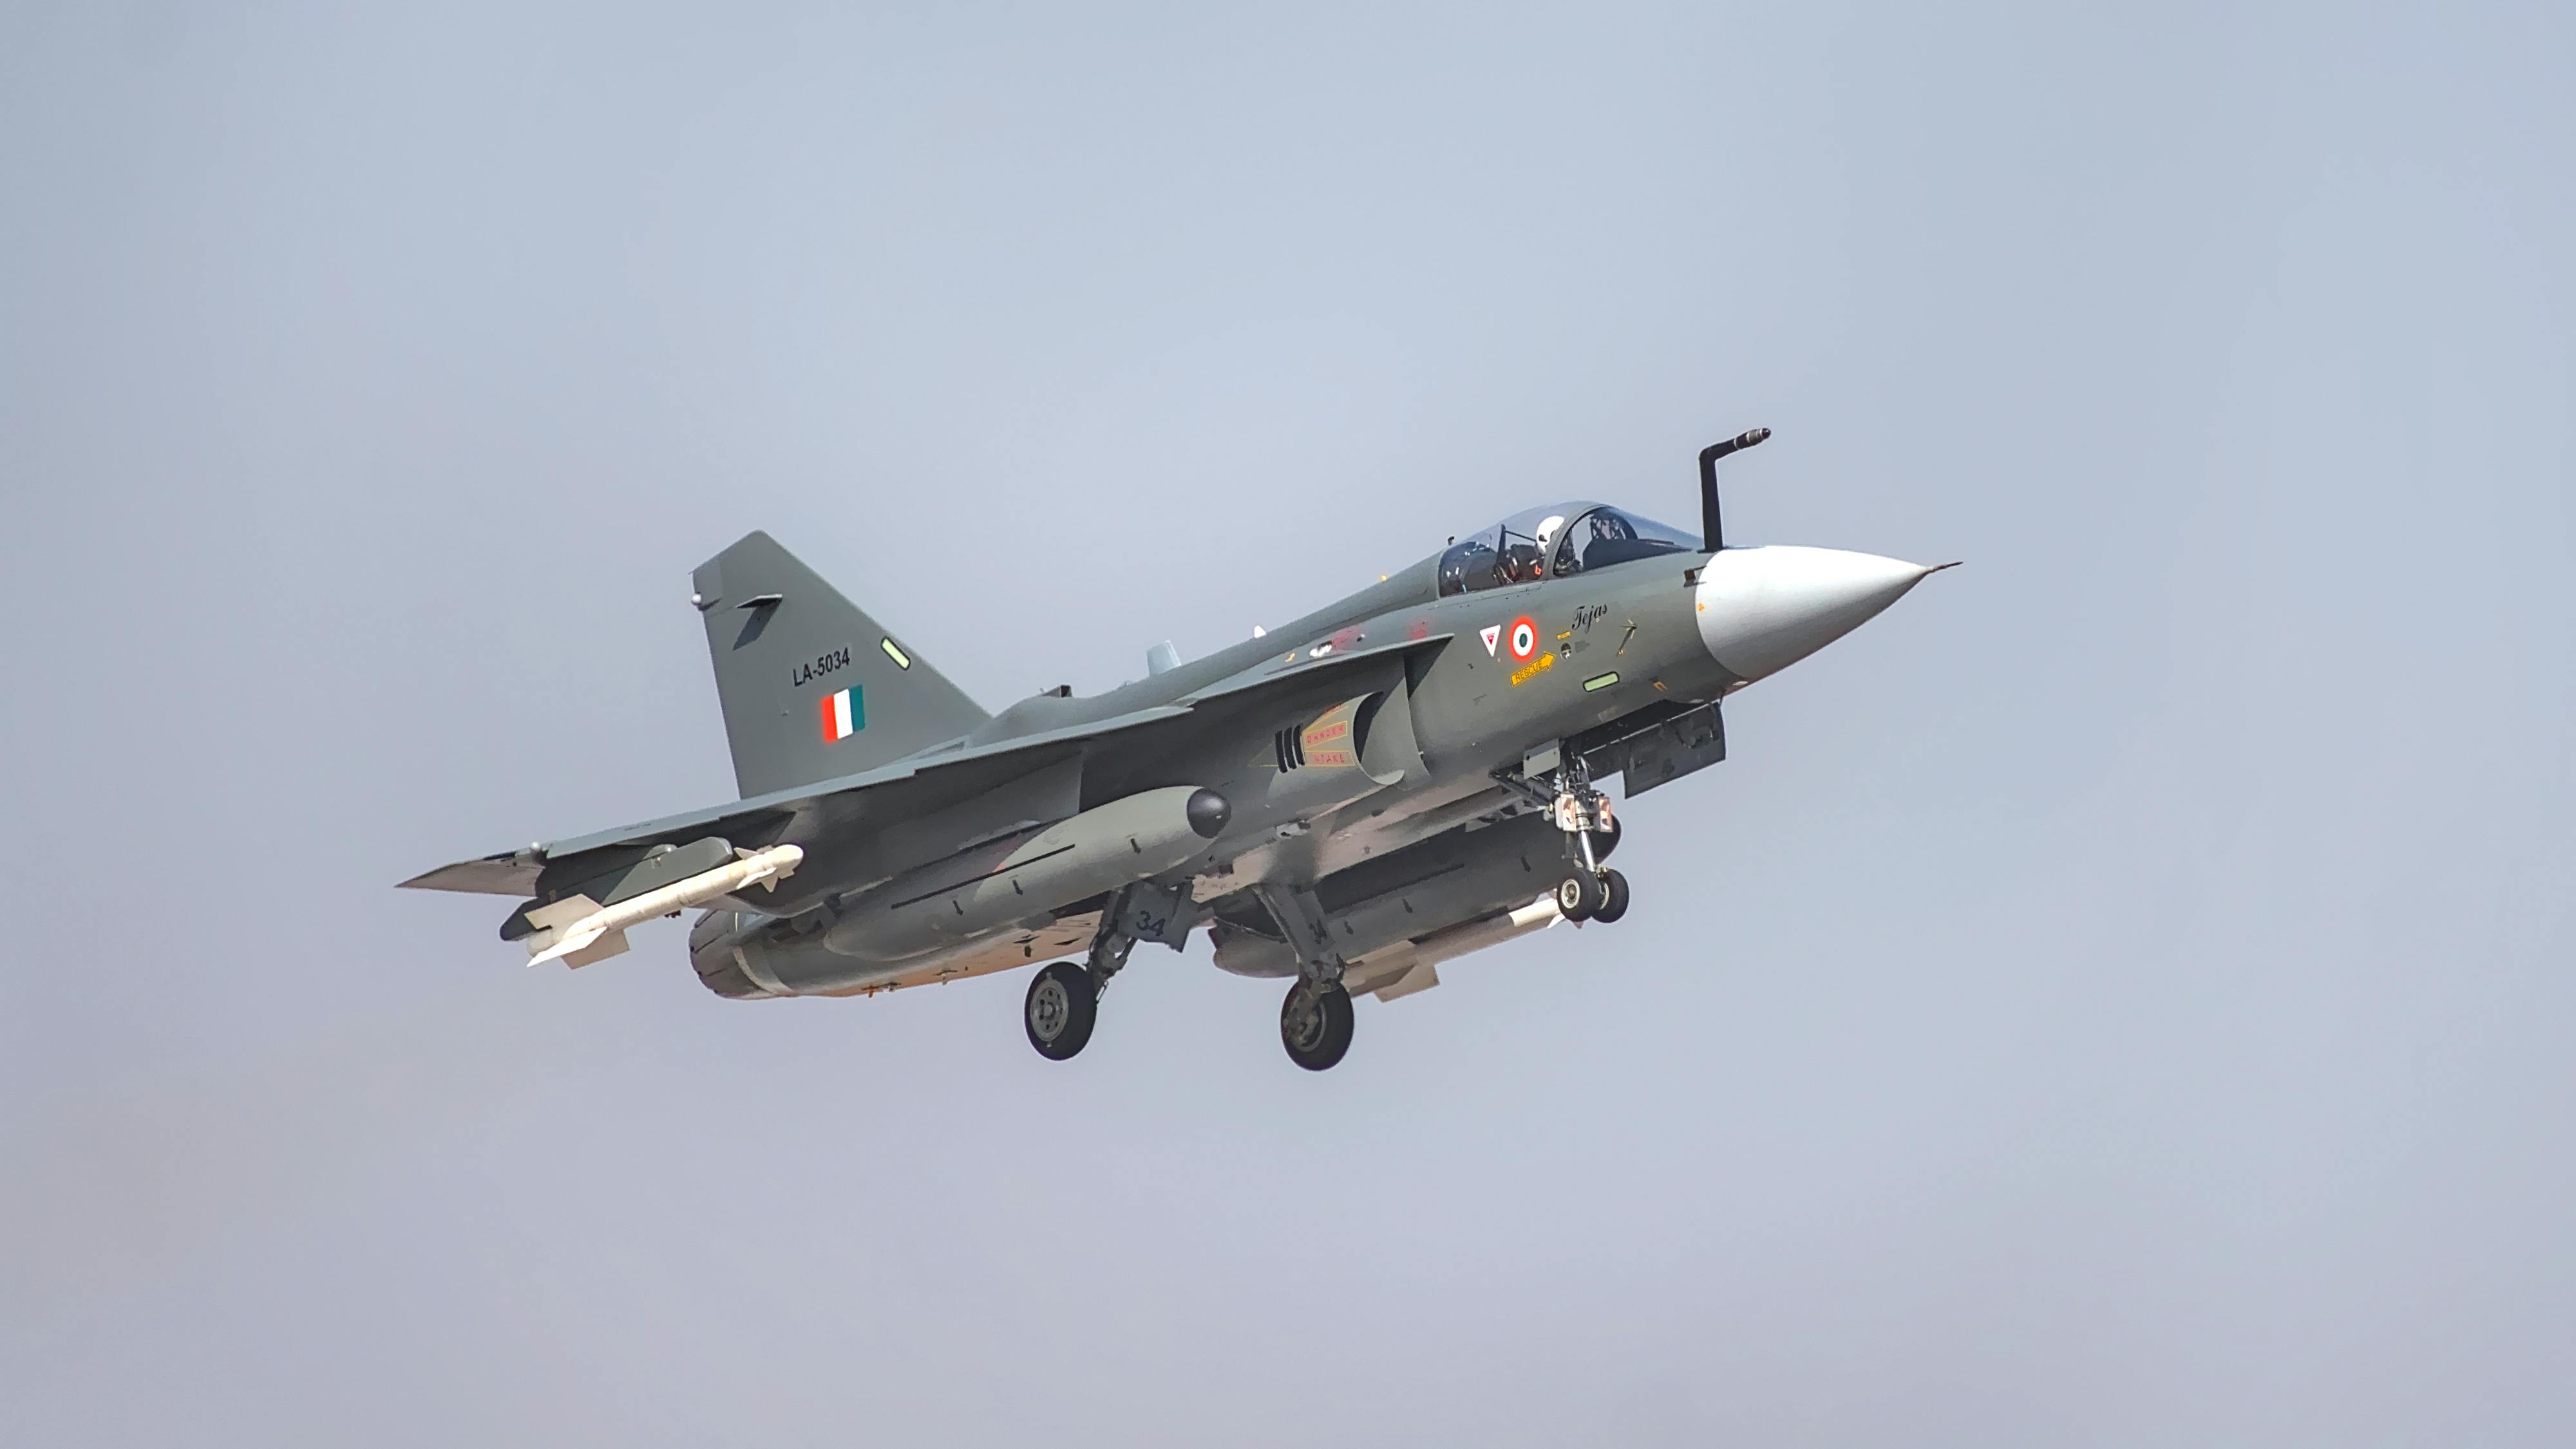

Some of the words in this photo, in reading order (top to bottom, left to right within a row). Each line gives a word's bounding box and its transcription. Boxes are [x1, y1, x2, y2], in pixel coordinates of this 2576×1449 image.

[1571, 604, 1607, 634] Tejas
[793, 647, 850, 687] LA-5034
[1515, 659, 1542, 682] RESCUE
[1136, 910, 1166, 936] 34
